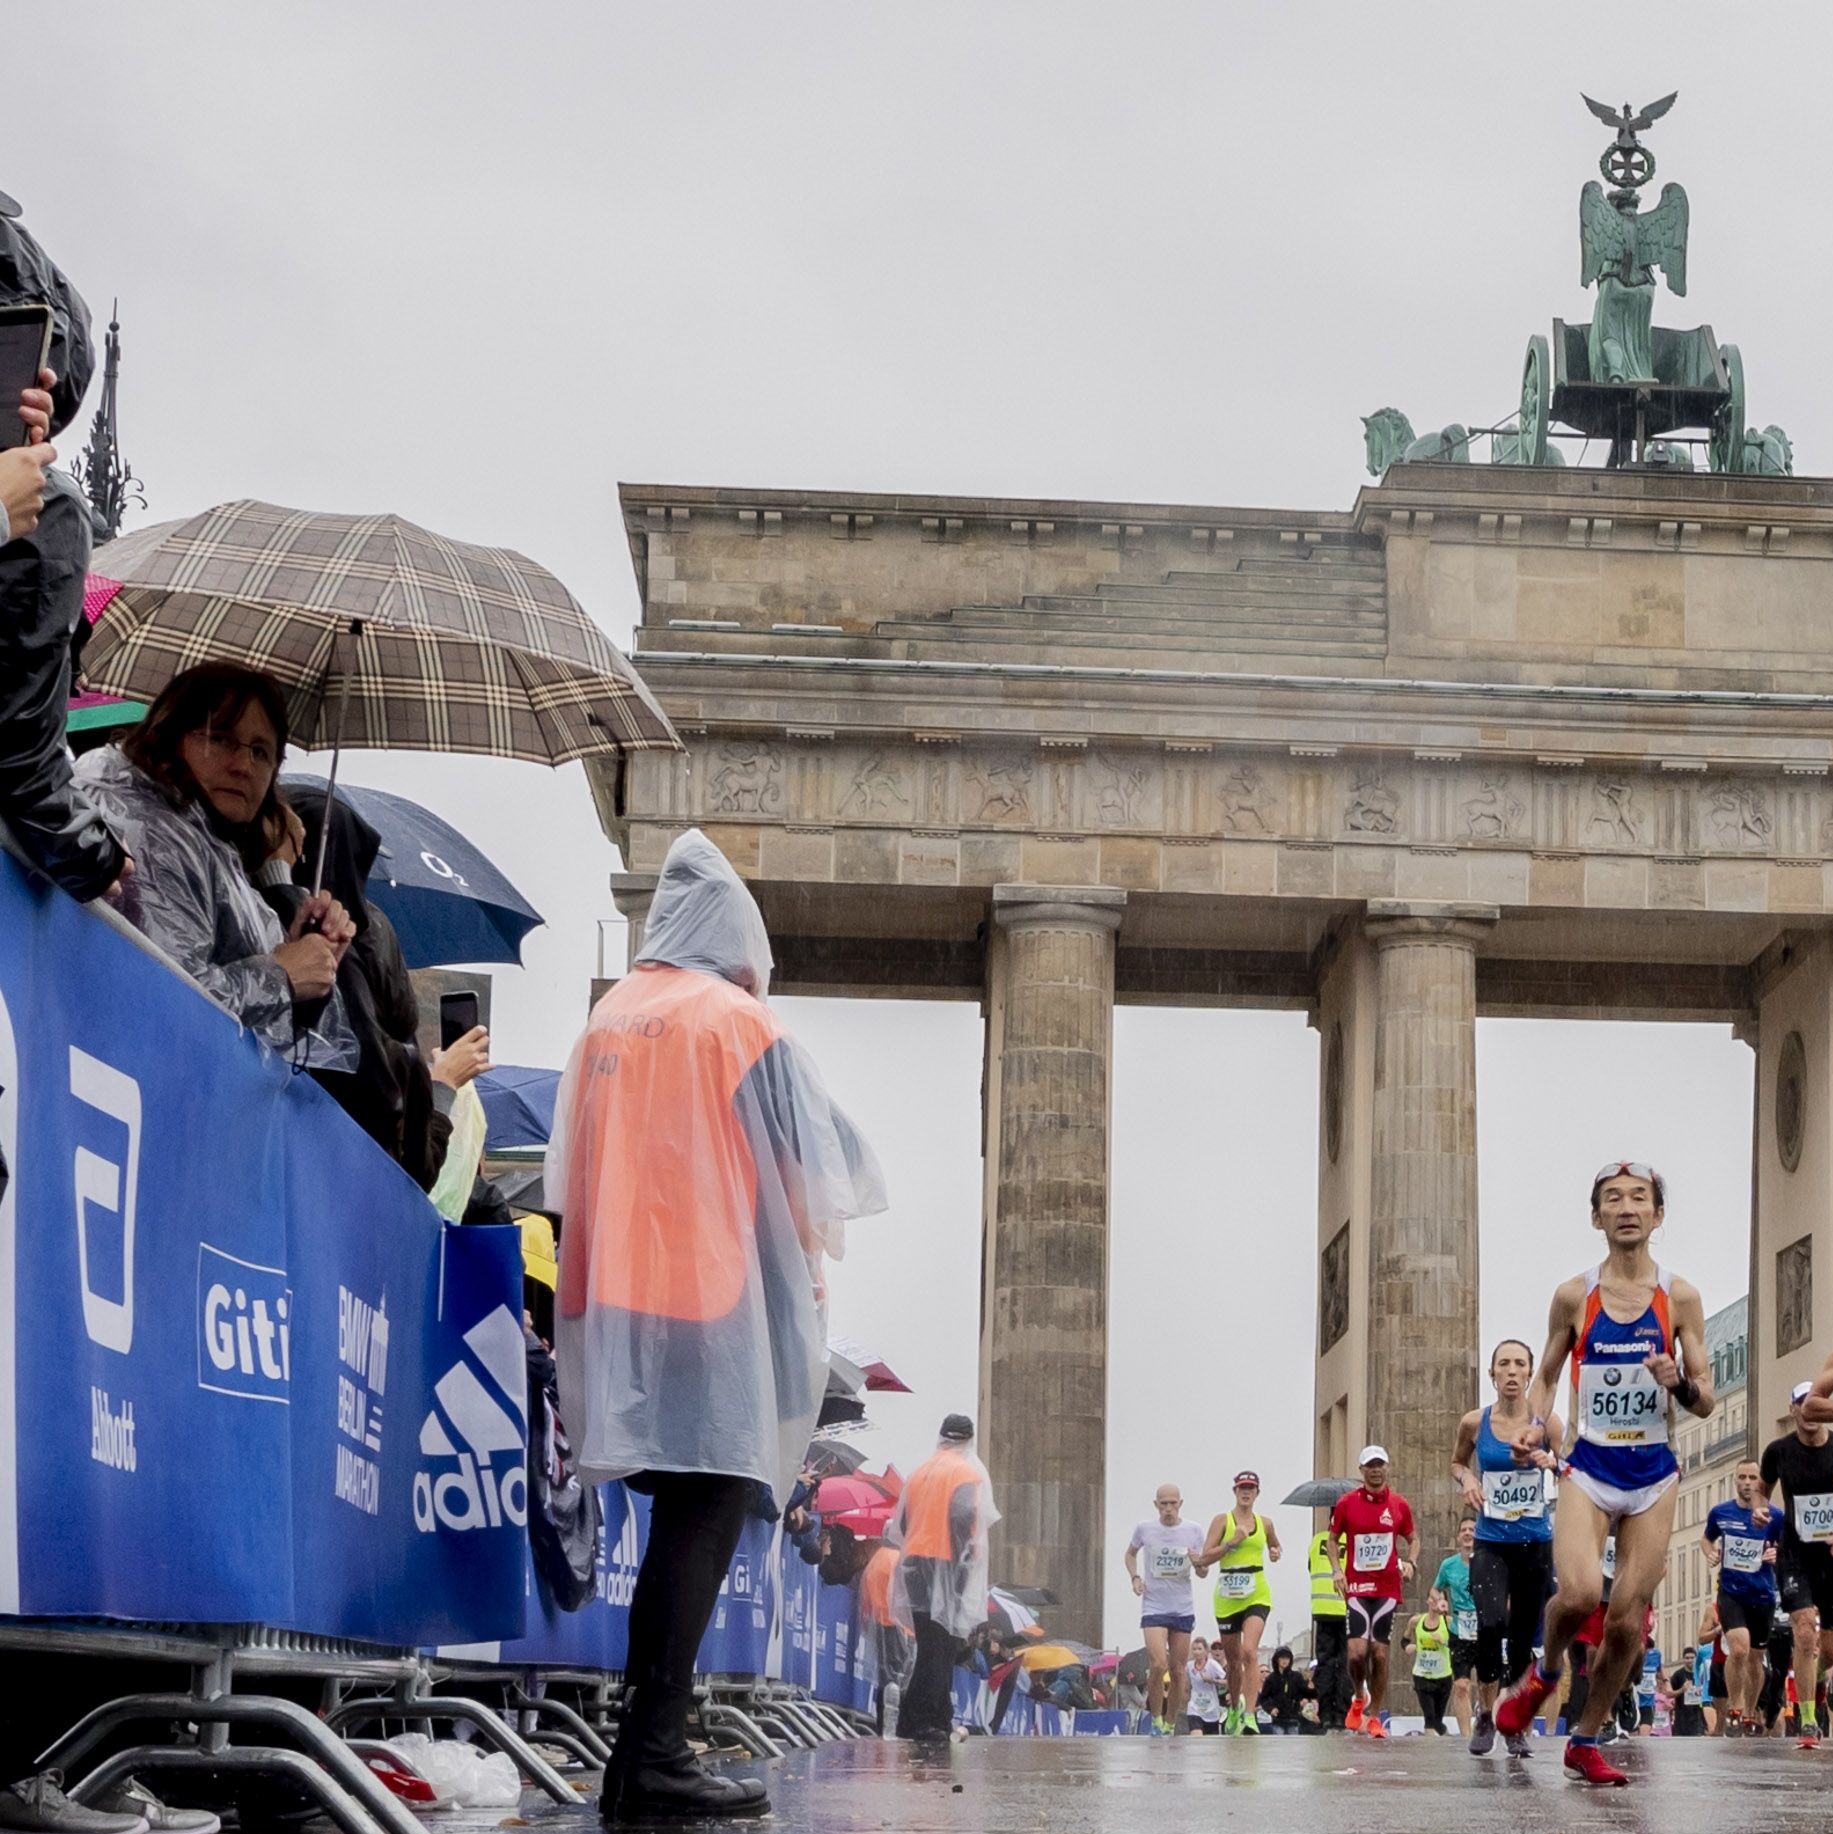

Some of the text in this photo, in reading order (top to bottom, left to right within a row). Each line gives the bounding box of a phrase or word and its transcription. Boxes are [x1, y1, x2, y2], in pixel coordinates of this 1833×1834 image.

[205, 1284, 289, 1381] Giti
[338, 1284, 373, 1376] BMW
[91, 1385, 136, 1473] Abbott
[338, 1375, 367, 1444] BERLIN
[1592, 1390, 1657, 1416] 56134
[335, 1443, 380, 1515] MARATHON
[1493, 1485, 1537, 1504] 50492
[607, 1564, 637, 1606] adid
[1359, 1545, 1388, 1558] 19720
